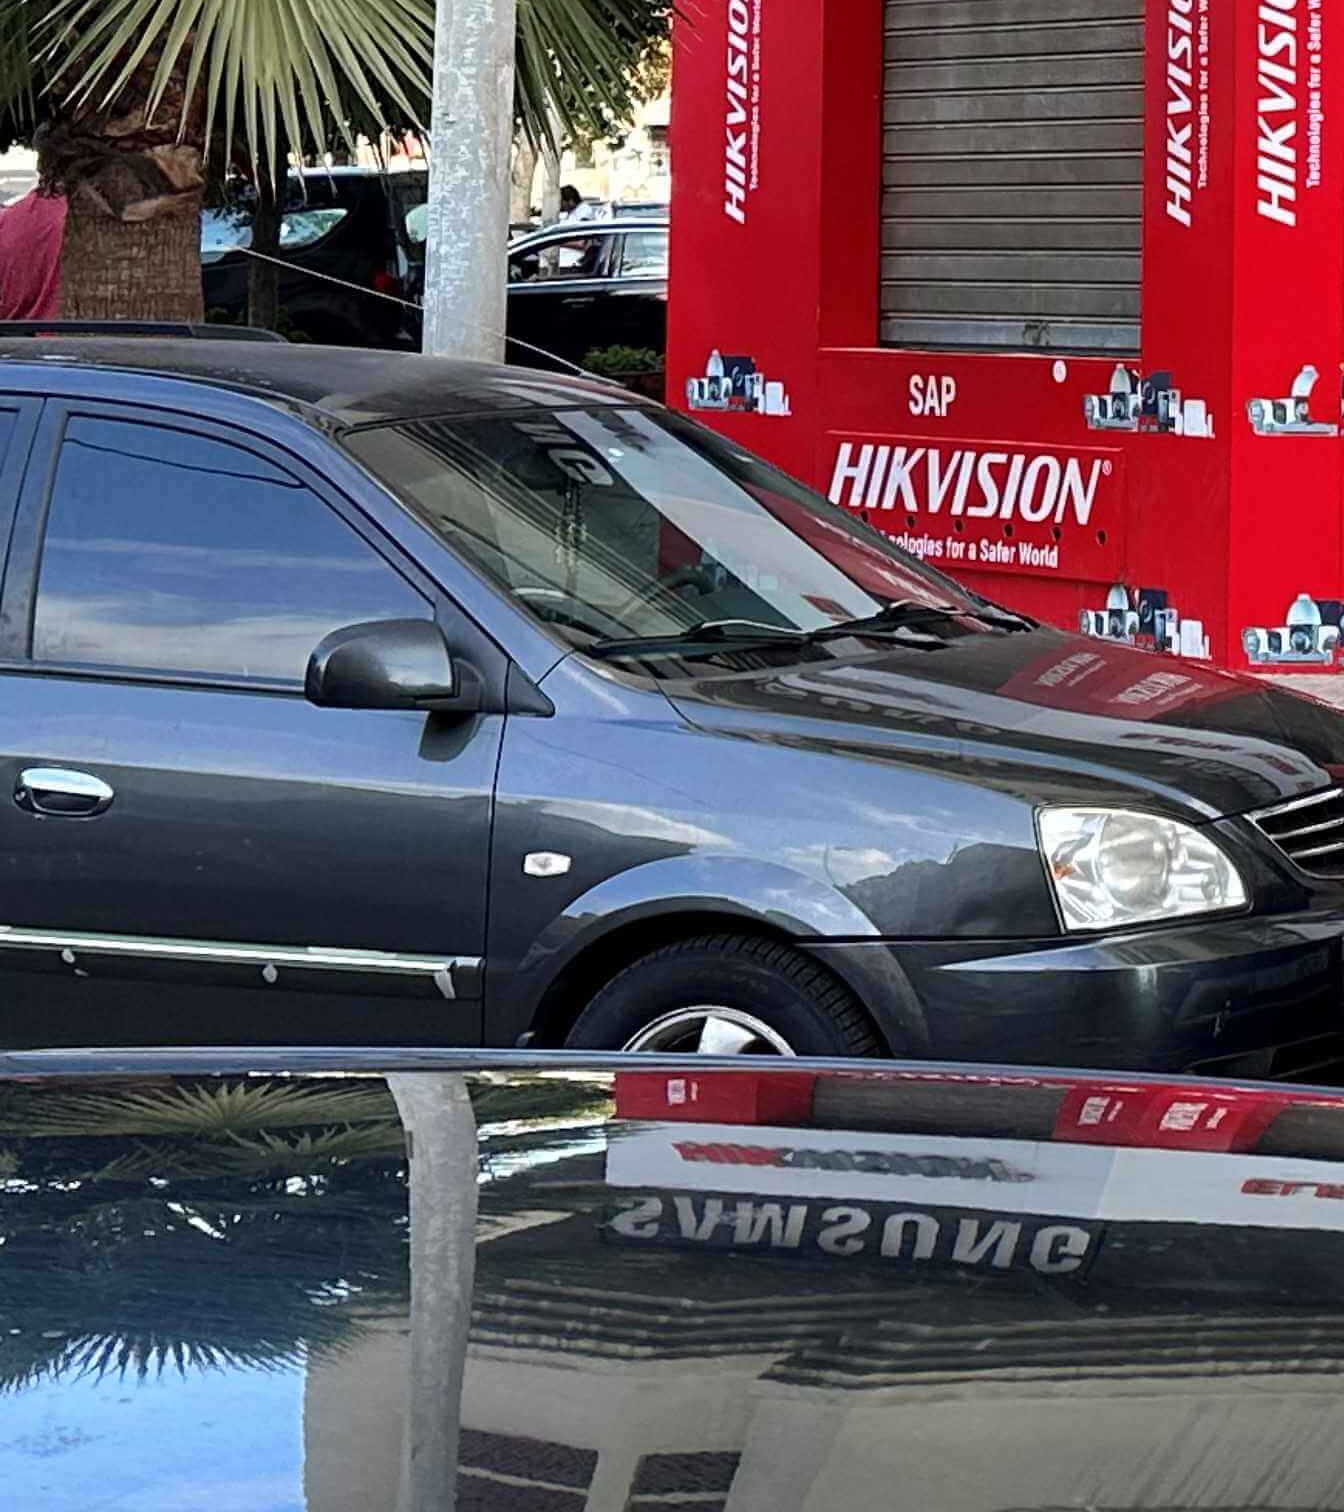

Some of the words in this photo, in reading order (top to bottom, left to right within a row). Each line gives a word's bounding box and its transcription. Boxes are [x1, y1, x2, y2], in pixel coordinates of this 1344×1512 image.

[1307, 12, 1322, 51] Safer
[1307, 66, 1321, 89] for
[1306, 91, 1324, 188] Technologies
[908, 374, 956, 417] SAP
[945, 536, 966, 559] for
[967, 542, 977, 561] a
[979, 538, 1017, 563] Safer
[1018, 542, 1058, 569] World
